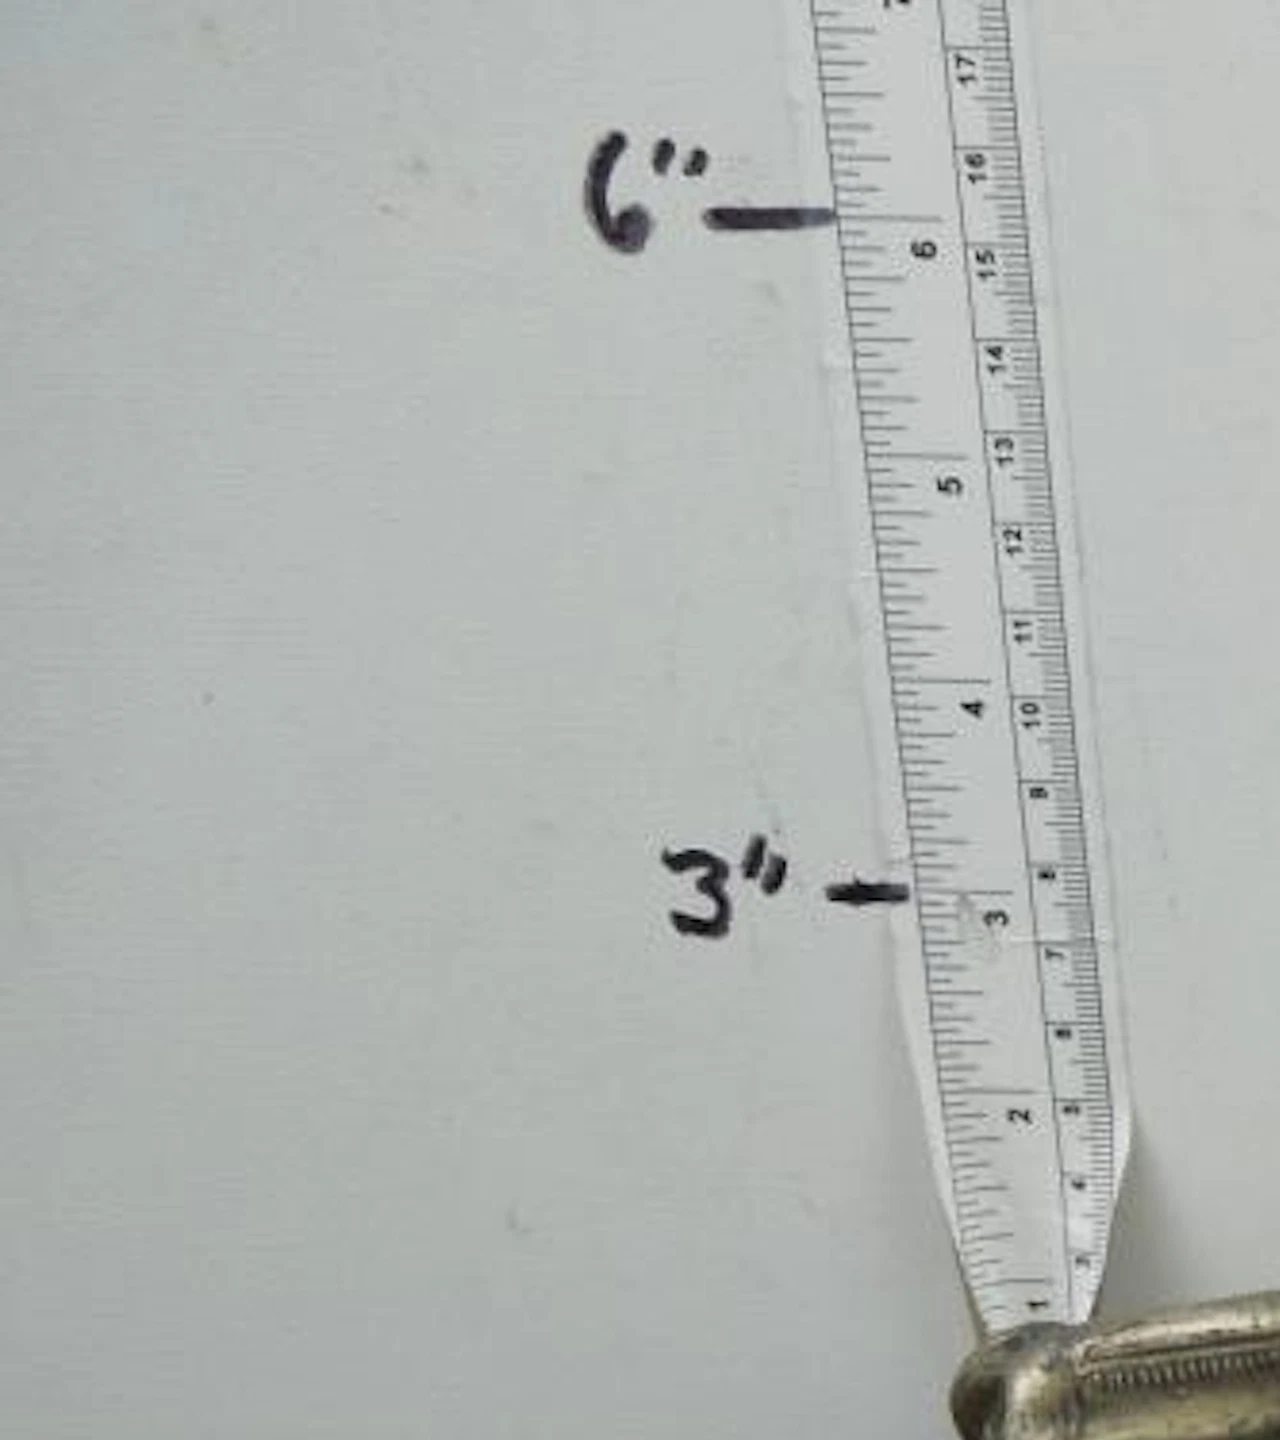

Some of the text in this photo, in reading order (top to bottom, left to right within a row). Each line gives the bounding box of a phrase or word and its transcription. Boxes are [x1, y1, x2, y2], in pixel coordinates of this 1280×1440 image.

[954, 54, 977, 86] 17
[964, 152, 987, 186] 16
[585, 131, 708, 254] 6"
[910, 239, 938, 261] 6
[975, 249, 996, 281] 15
[985, 345, 1006, 376] 14
[993, 437, 1015, 468] 13
[936, 476, 963, 496] 5
[1002, 528, 1024, 557] 12
[1013, 619, 1032, 645] 11
[960, 700, 985, 720] 4
[1020, 702, 1041, 730] 10
[661, 834, 788, 939] 3"
[982, 908, 1011, 929] 3
[1007, 1108, 1032, 1125] 2
